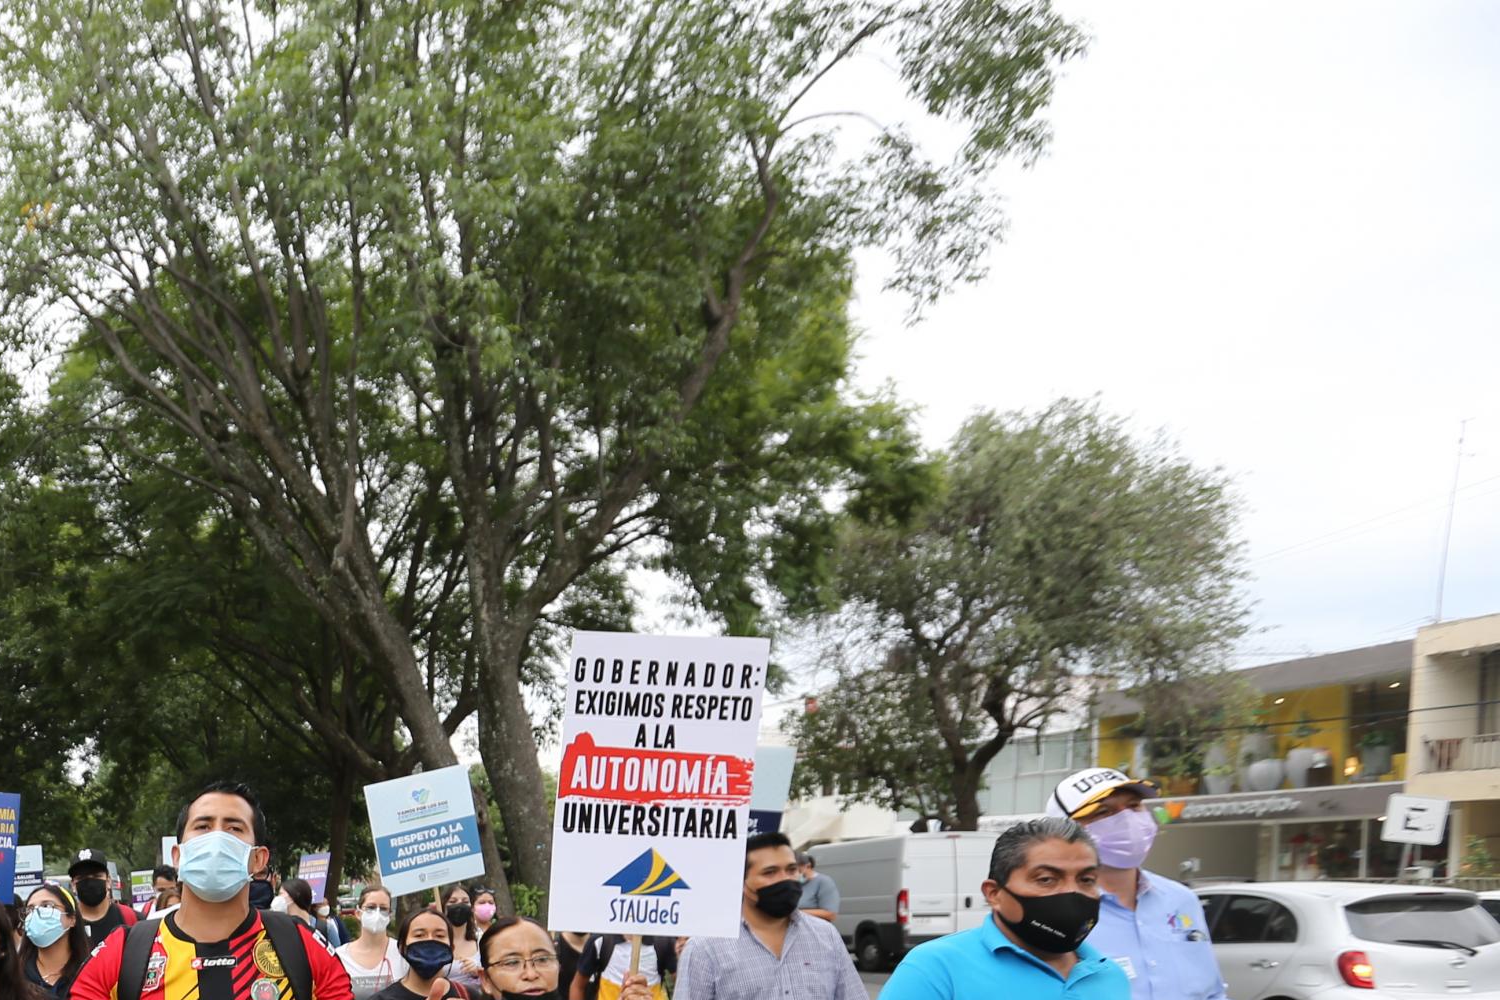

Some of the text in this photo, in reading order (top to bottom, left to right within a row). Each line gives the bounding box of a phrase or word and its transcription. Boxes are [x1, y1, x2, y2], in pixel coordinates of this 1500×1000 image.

[574, 657, 761, 689] GOBERNADOR:
[574, 690, 753, 721] EXIGIMOS RESPETO
[634, 723, 675, 749] A LA
[570, 755, 729, 795] AUTONOMÍA
[562, 802, 738, 840] UNIVERSITARIA
[390, 822, 464, 848] RESPETO A LA
[397, 834, 461, 858] AUTONOMÍA
[390, 844, 471, 870] UNIVERSITARIA
[609, 898, 680, 925] STAUdeG
[203, 958, 236, 967] lotto
